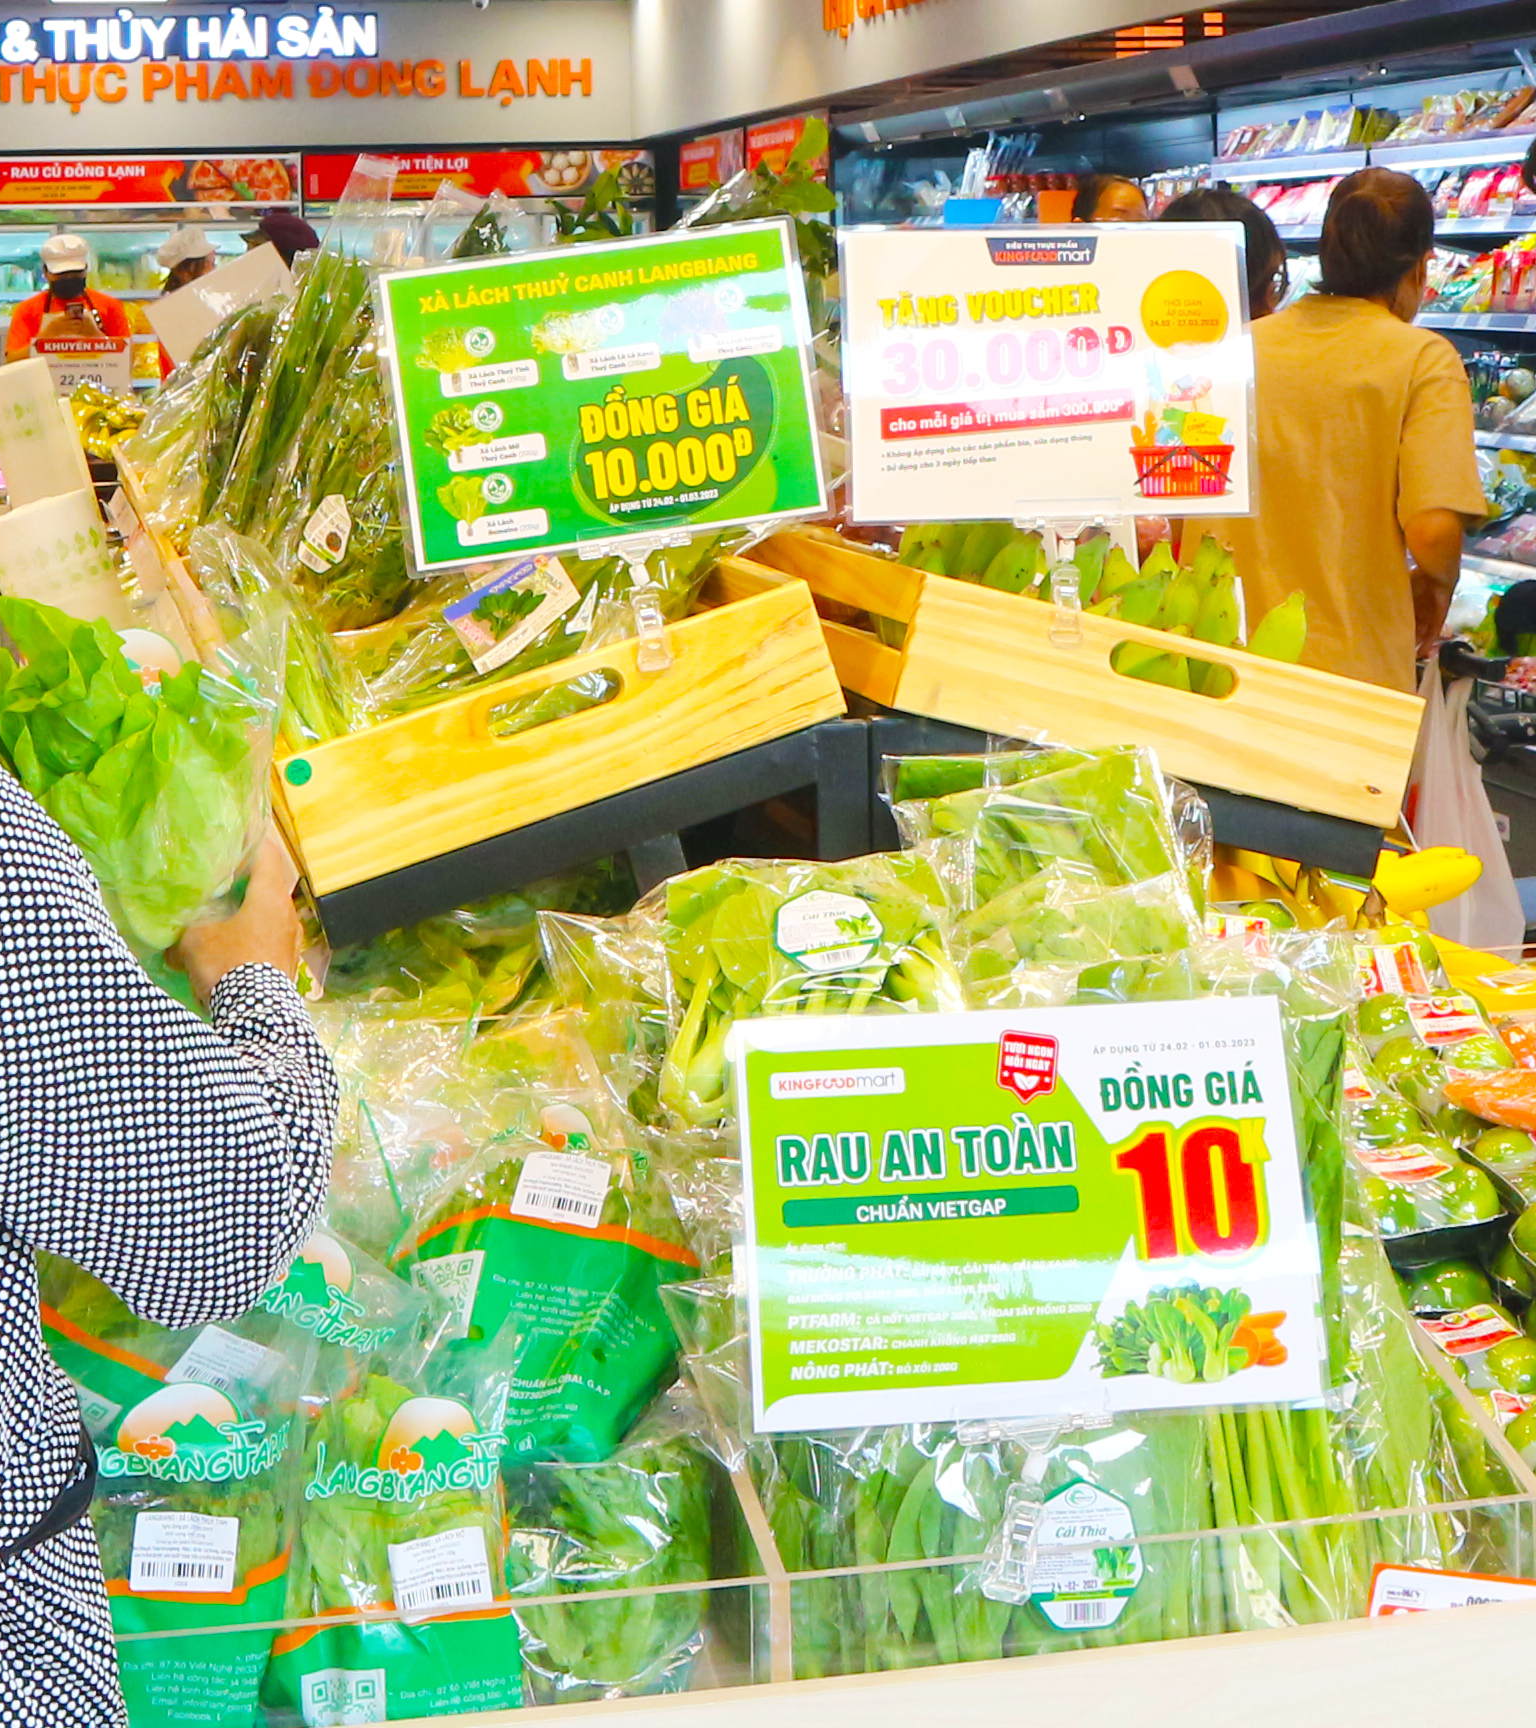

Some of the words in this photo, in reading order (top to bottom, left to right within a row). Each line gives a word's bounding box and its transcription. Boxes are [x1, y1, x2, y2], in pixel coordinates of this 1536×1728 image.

[1, 19, 39, 63] &
[44, 8, 178, 61] THỦY
[186, 7, 264, 59] HẢI
[276, 5, 377, 58] SẢN
[460, 57, 593, 106] LẠNH
[10, 167, 40, 179] RAU
[107, 165, 146, 181] LẠNH
[419, 292, 450, 315] XÀ
[453, 282, 511, 311] LÁCH
[573, 269, 634, 294] CANH
[638, 252, 759, 287] LANGBIANG
[966, 282, 1099, 322] VOUCHER
[579, 384, 679, 447] ĐỒNG
[685, 374, 751, 430] GIÁ
[889, 418, 917, 432] cho
[920, 410, 948, 430] mỗi
[950, 410, 973, 431] giá
[976, 411, 992, 428] trị
[995, 410, 1026, 423] mua
[1093, 1044, 1107, 1055] ÁP
[1160, 1041, 1189, 1052] 24.02
[1199, 1038, 1256, 1050] 01.03.2023
[1100, 1060, 1194, 1112] ĐỒNG
[1204, 1060, 1264, 1106] GIÁ
[777, 1133, 868, 1186] RAU
[881, 1130, 946, 1180] AN
[955, 1114, 1078, 1176] TOÀN
[855, 1195, 924, 1223] CHUẨN
[927, 1197, 1008, 1220] VIETGAP
[787, 1312, 862, 1330] PTFARM:
[789, 1335, 889, 1354] MEKOSTAR:
[891, 1338, 928, 1349] CHANH
[790, 1360, 841, 1380] NÔNG
[843, 1358, 895, 1378] PHÁT:
